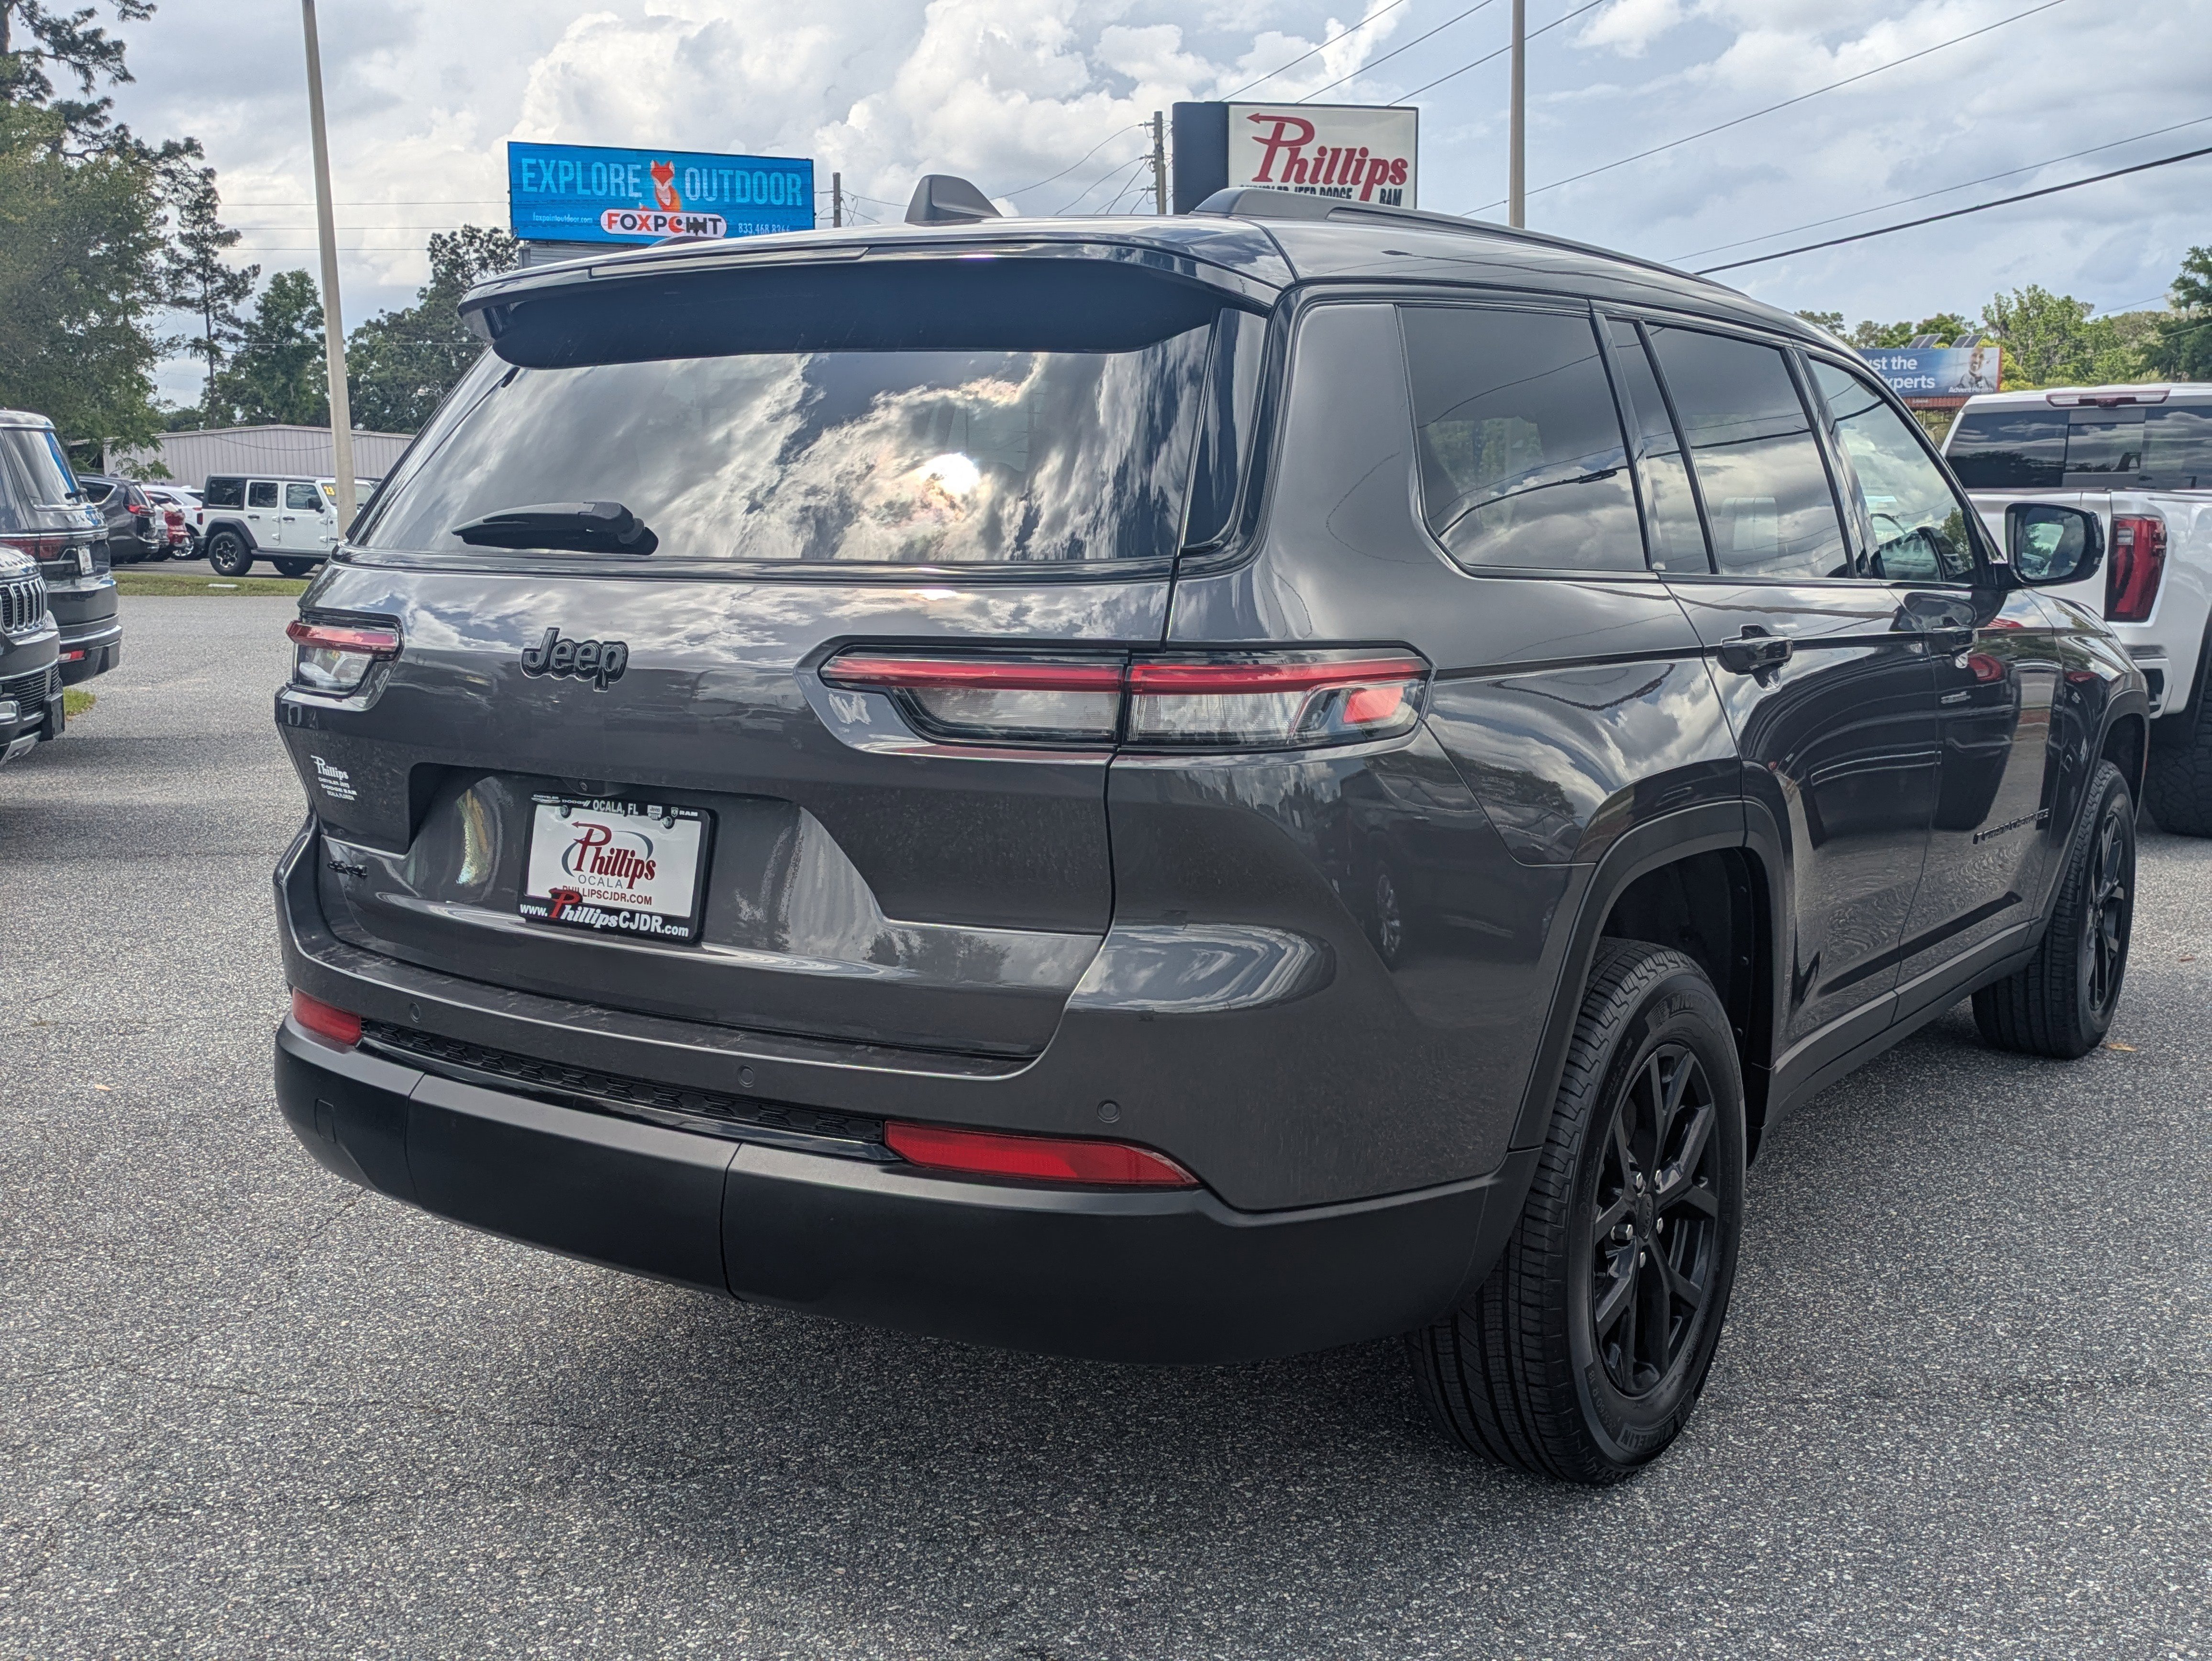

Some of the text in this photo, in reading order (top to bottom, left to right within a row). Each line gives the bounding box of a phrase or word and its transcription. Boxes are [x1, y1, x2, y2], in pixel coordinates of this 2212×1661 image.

[1247, 112, 1408, 201] Phillips
[522, 158, 802, 206] EXPLORE OUTDOOR
[1379, 188, 1402, 206] RAM
[607, 213, 721, 234] FOXPOINT
[1868, 355, 1917, 370] st the
[1881, 375, 1936, 391] xperts
[323, 486, 335, 496] 23
[520, 628, 629, 692] Jeep
[310, 755, 349, 780] Phillips
[592, 799, 639, 815] OCALA, FL
[571, 821, 656, 889] Phillips
[578, 875, 623, 889] OCALA
[520, 887, 689, 937] www.PhillipsCJDR.com
